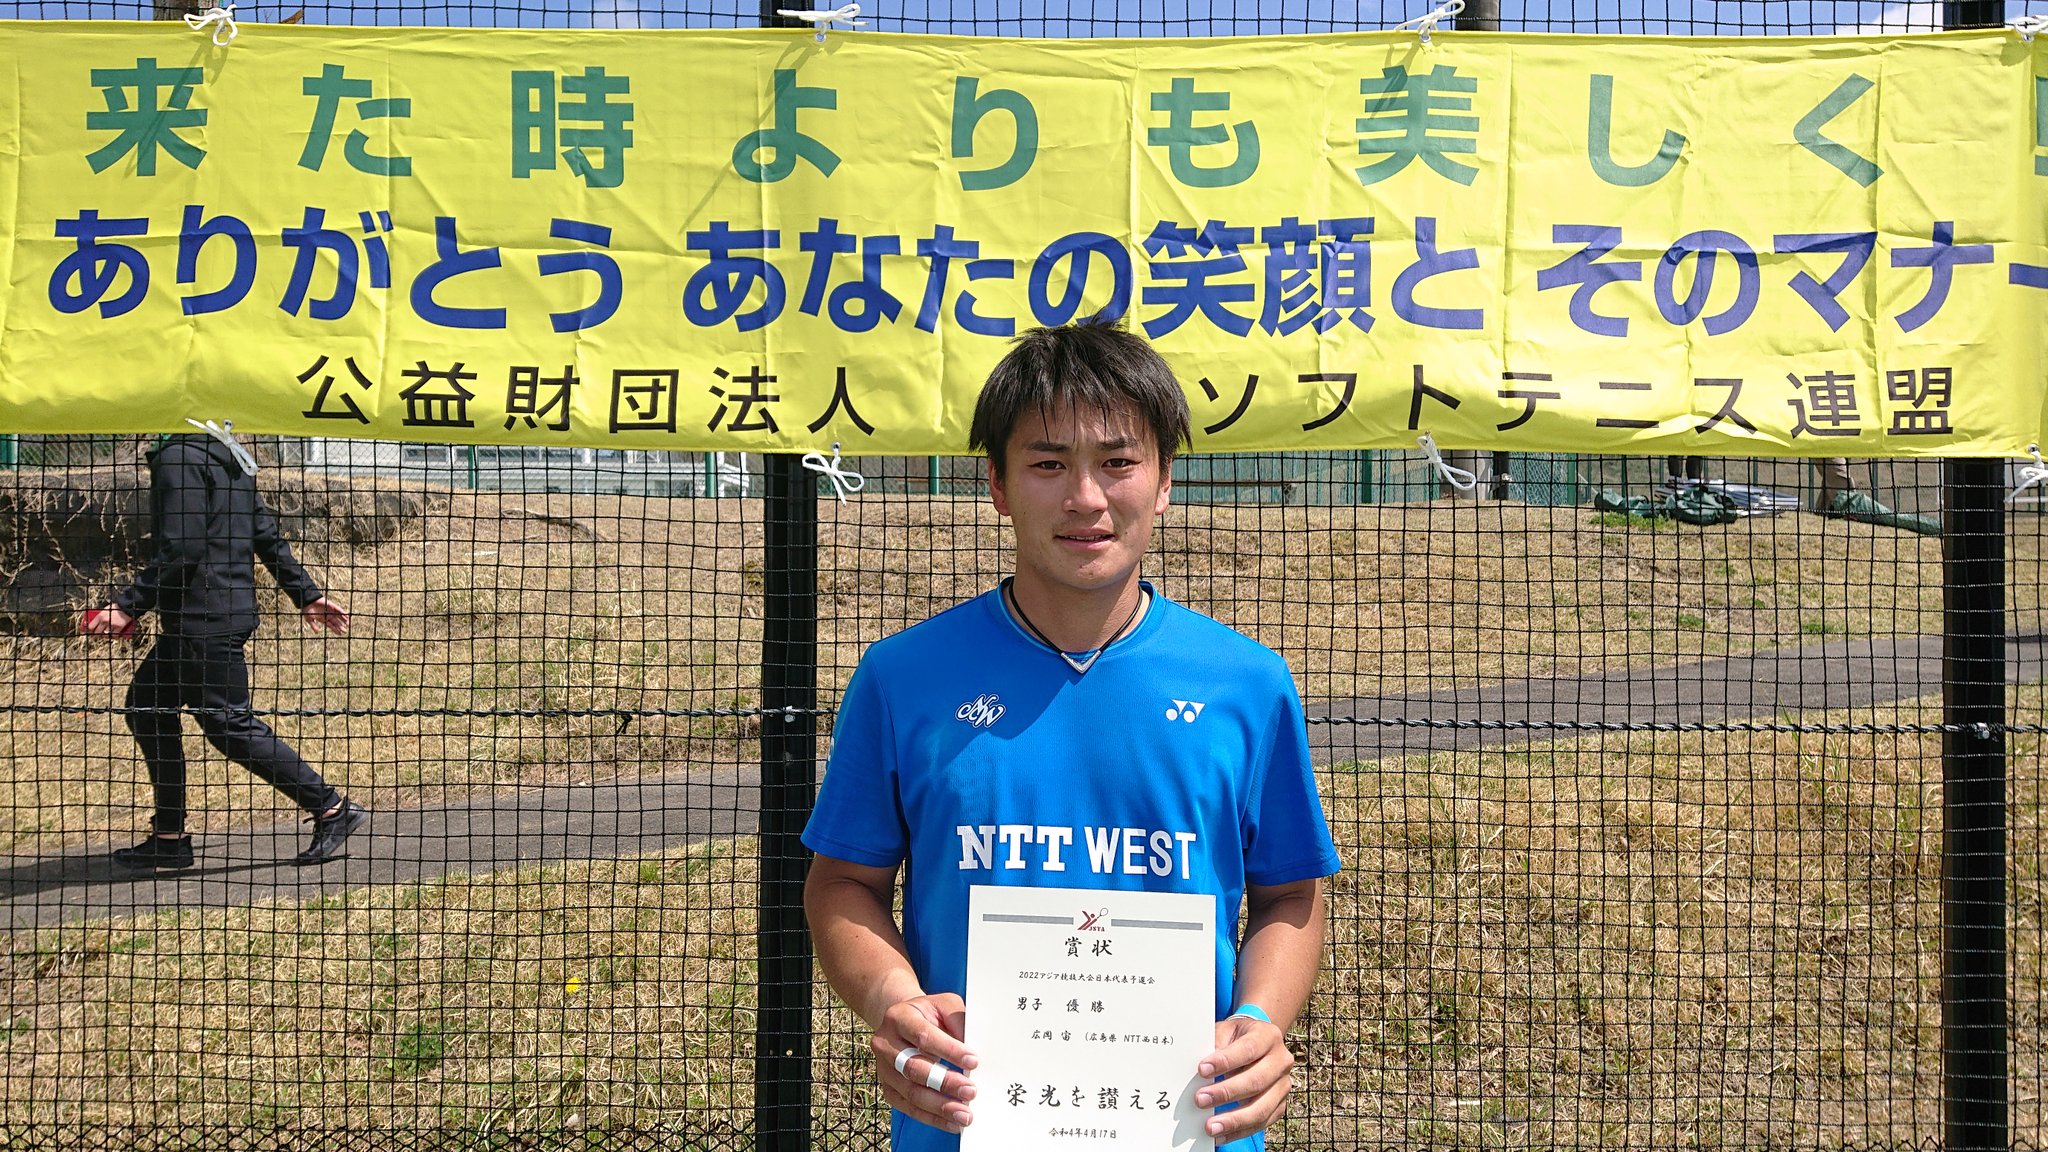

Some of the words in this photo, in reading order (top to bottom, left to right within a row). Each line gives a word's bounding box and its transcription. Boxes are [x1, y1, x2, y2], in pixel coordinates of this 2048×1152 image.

[85, 57, 2048, 189] 来た時よりも美しく
[48, 205, 623, 333] ありがとう
[683, 217, 1484, 340] あなたの笑顔と
[297, 355, 875, 434] 公益財団法人
[957, 825, 1072, 871] NTT
[1086, 827, 1196, 880] WEST
[1064, 936, 1113, 957] 賞状
[1007, 1082, 1171, 1110] 栄光を讃える
